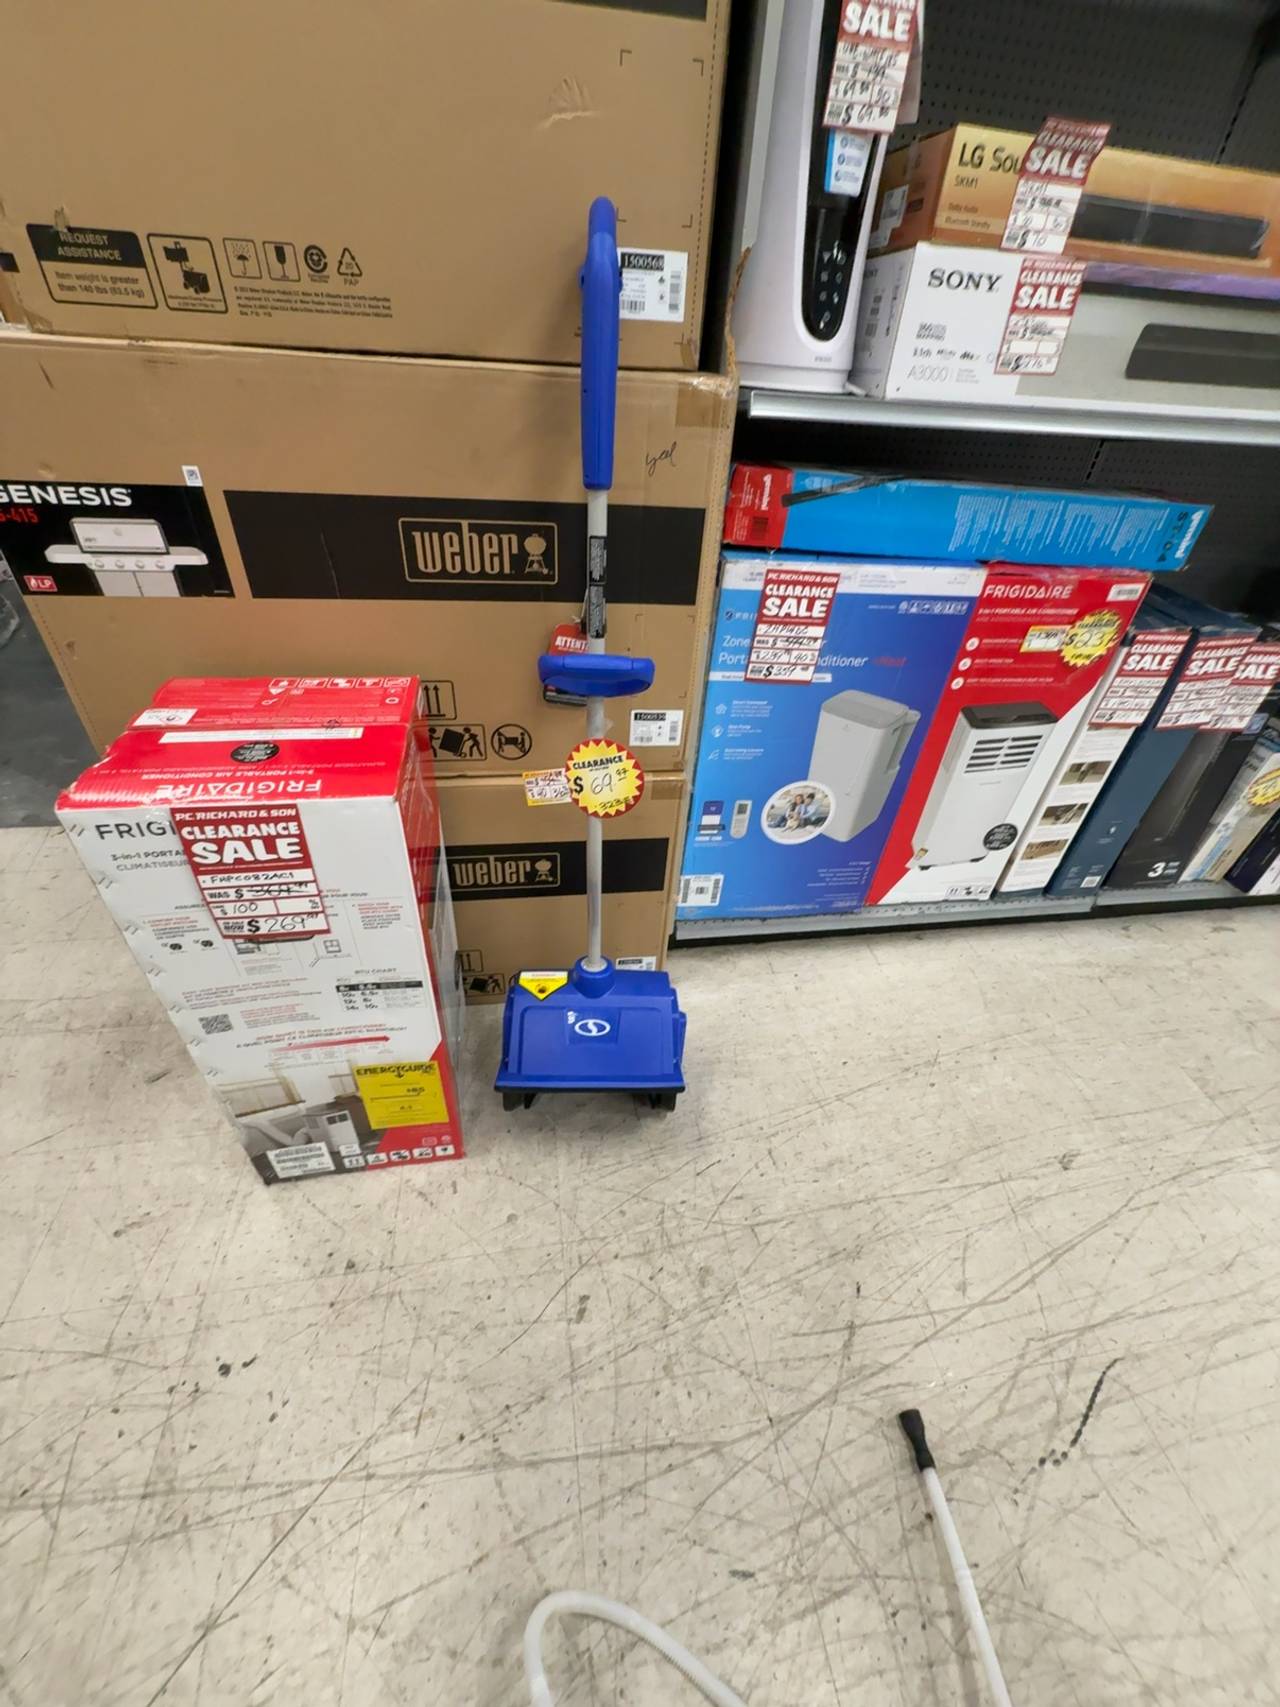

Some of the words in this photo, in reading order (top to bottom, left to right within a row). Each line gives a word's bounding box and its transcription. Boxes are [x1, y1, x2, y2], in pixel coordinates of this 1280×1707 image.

[843, 1, 913, 42] SALE
[958, 142, 985, 169] LG
[1025, 145, 1090, 179] SALE
[59, 231, 109, 245] REQUEST
[57, 245, 123, 261] ASSISTANCE
[927, 266, 1002, 293] SONY
[1014, 285, 1080, 311] SALE
[411, 520, 519, 574] weber
[765, 583, 835, 598] CLEARANCE
[983, 584, 1075, 600] FRIGIDAIRE
[762, 597, 830, 619] SALE
[1131, 643, 1184, 654] CLEARANCE
[1191, 645, 1249, 660] CLEARANCE
[763, 664, 774, 678] $
[1121, 654, 1178, 671] SALE
[1184, 656, 1242, 676] SALE
[572, 754, 623, 770] CLEARANCE
[142, 772, 212, 781] CONDITIONER
[213, 771, 236, 779] AIR
[239, 770, 291, 778] PORTABLE
[155, 778, 322, 798] FRIGIDAIRE
[573, 775, 584, 795] $
[590, 772, 613, 795] 69
[195, 810, 258, 820] RICHARD
[259, 810, 269, 818] &
[270, 808, 296, 817] SON
[181, 822, 300, 840] CLEARANCE
[191, 837, 304, 864] SALE
[452, 856, 531, 887] weber
[1147, 861, 1167, 878] 3
[208, 891, 230, 900] WAS
[234, 889, 245, 900] $
[232, 903, 258, 915] 100
[246, 919, 261, 934] $
[264, 915, 307, 933] 269
